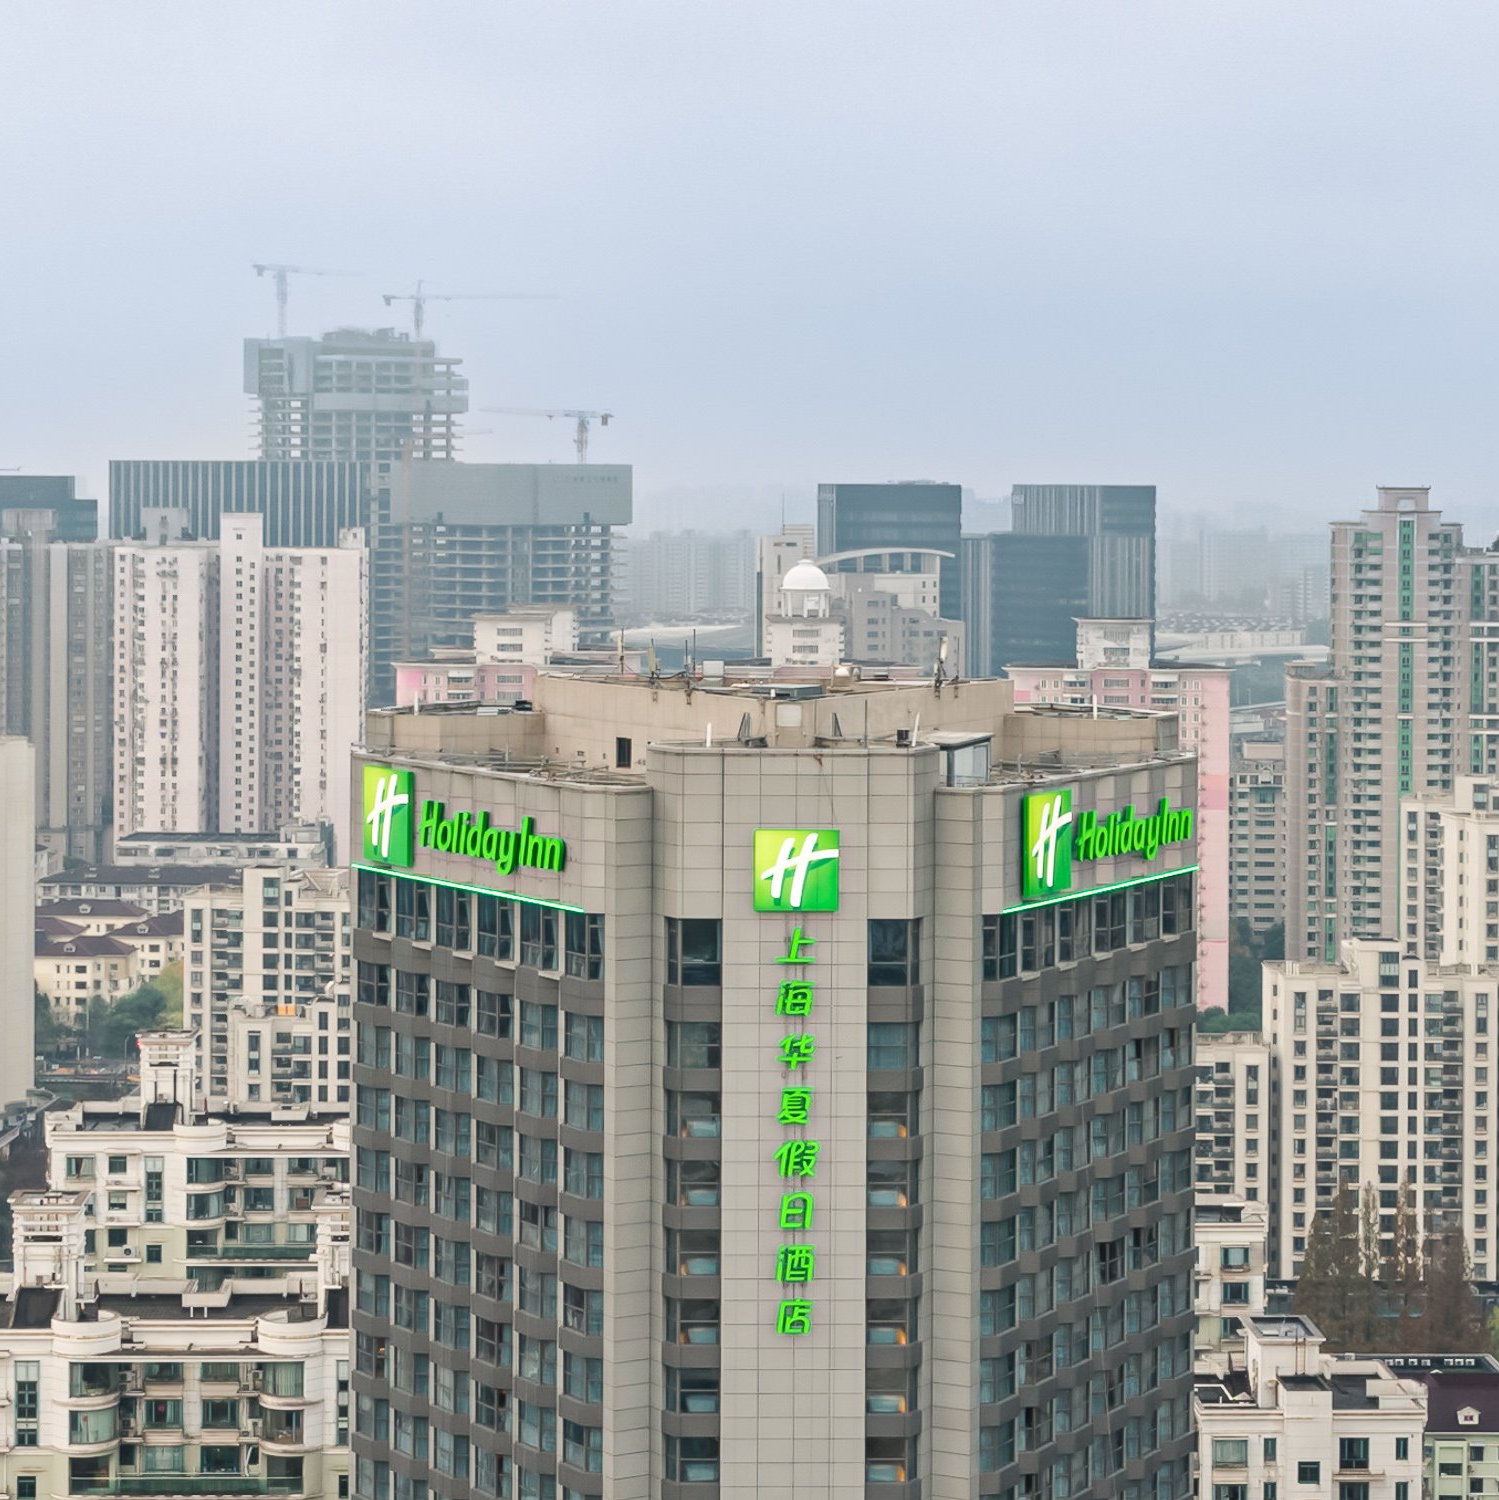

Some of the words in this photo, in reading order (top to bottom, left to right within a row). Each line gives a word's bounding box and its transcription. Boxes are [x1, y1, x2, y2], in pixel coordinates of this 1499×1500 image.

[418, 800, 521, 876] Holiday
[519, 815, 566, 873] Inn
[1076, 804, 1161, 862] Holiday
[1160, 796, 1194, 846] Inn
[773, 927, 820, 1337] 上海华夏假日酒店
